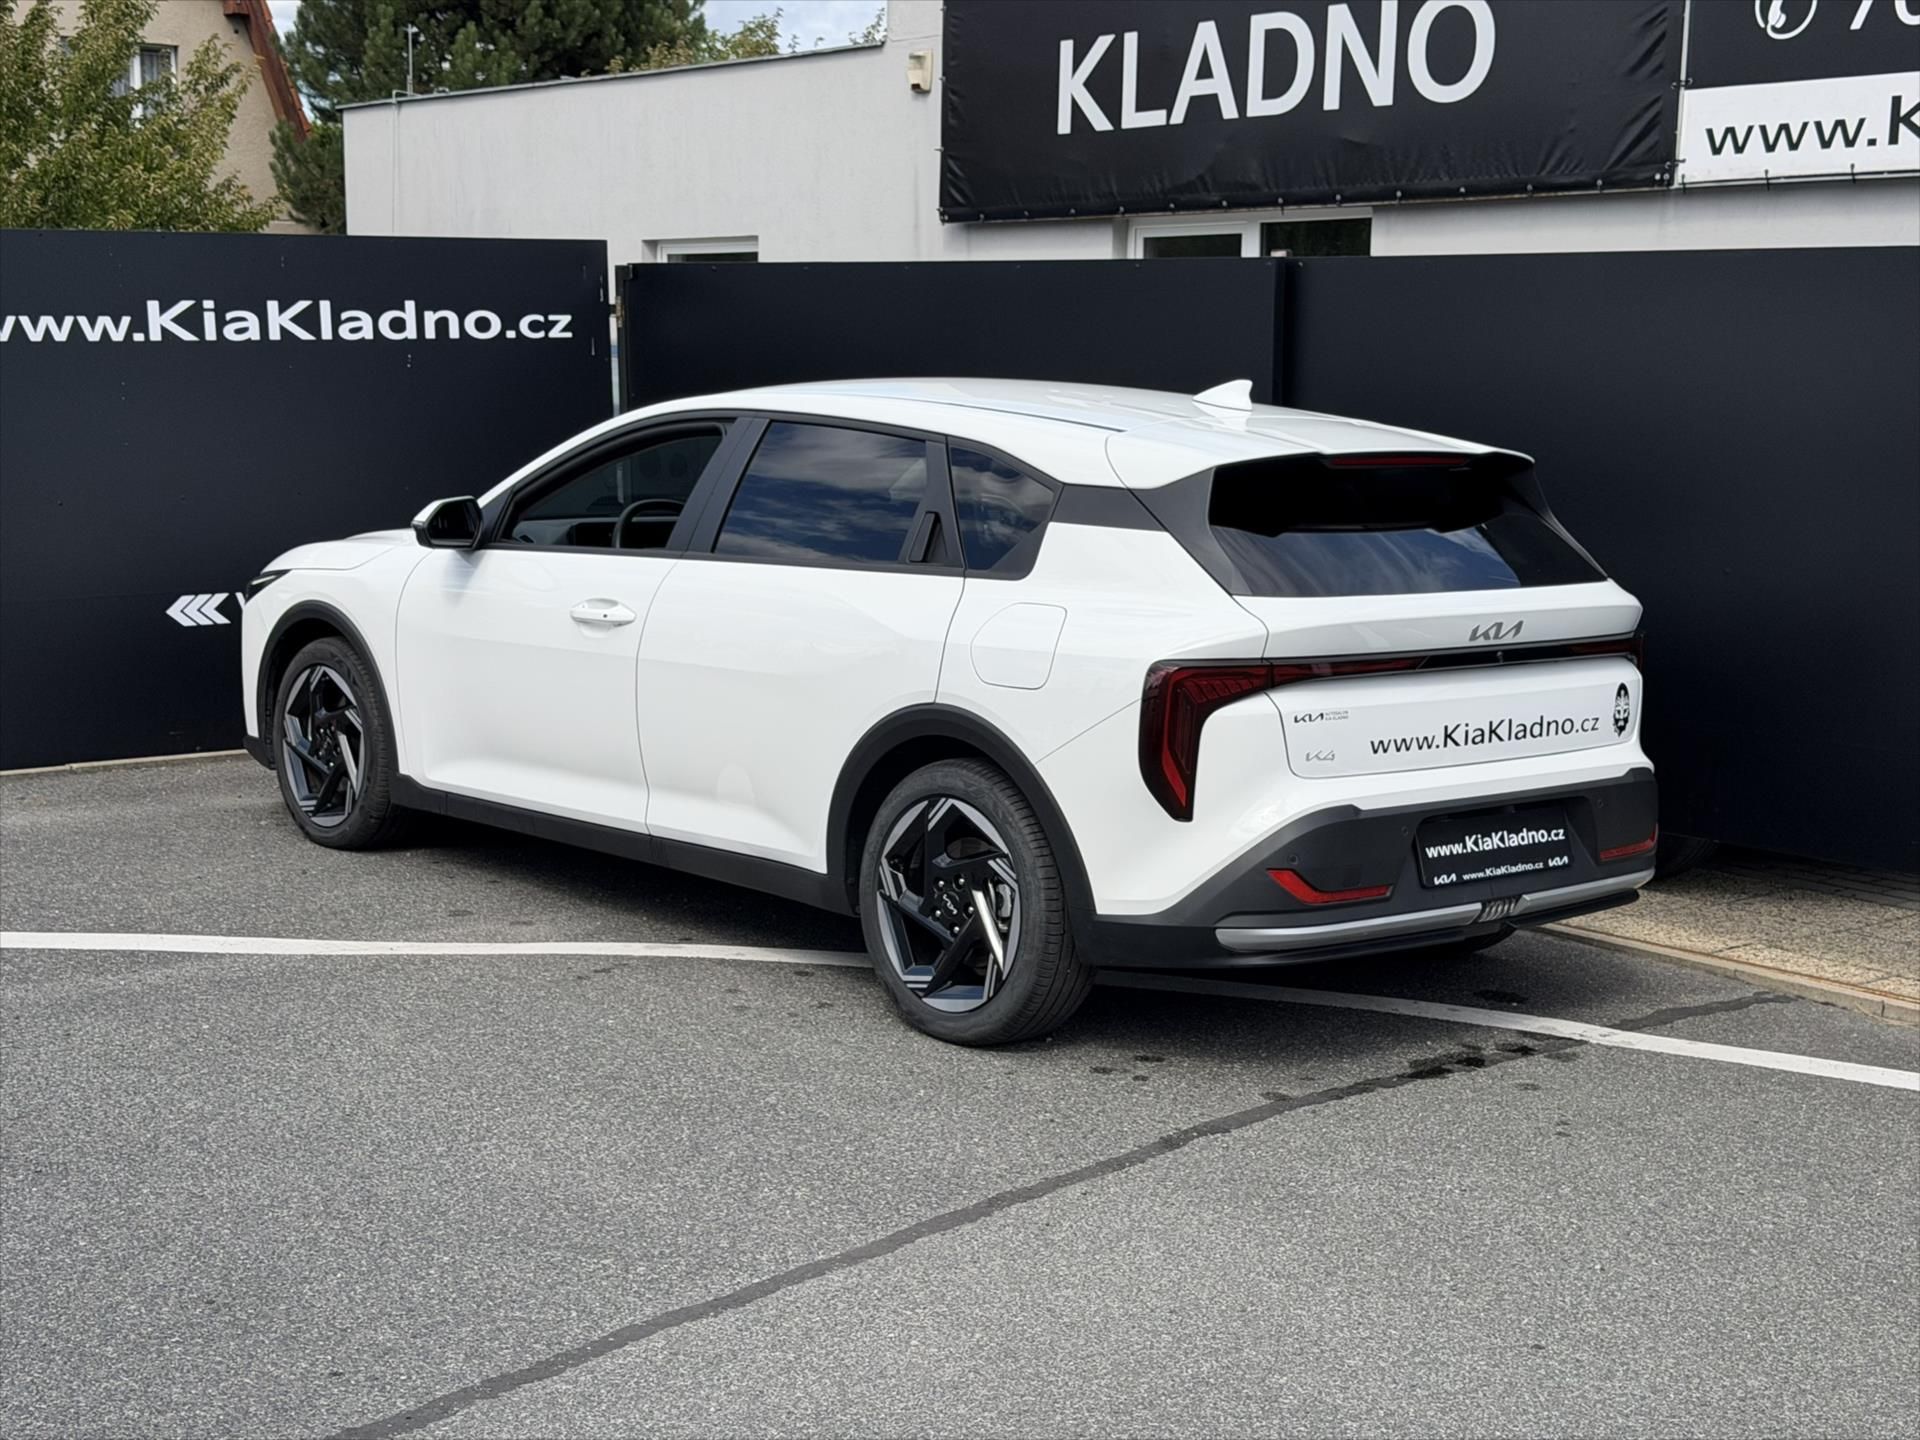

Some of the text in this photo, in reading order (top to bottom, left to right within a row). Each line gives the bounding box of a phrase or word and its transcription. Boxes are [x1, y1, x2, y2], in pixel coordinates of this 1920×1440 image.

[1057, 0, 1496, 134] KLADNO
[0, 300, 573, 342] ww.KiaKladno.cz
[1469, 620, 1523, 641] KIA
[1370, 715, 1600, 754] www.KiaKladno.cz
[1425, 828, 1565, 858] www.KiaKladno.cz
[1462, 861, 1544, 881] www.KiaKladno.cz
